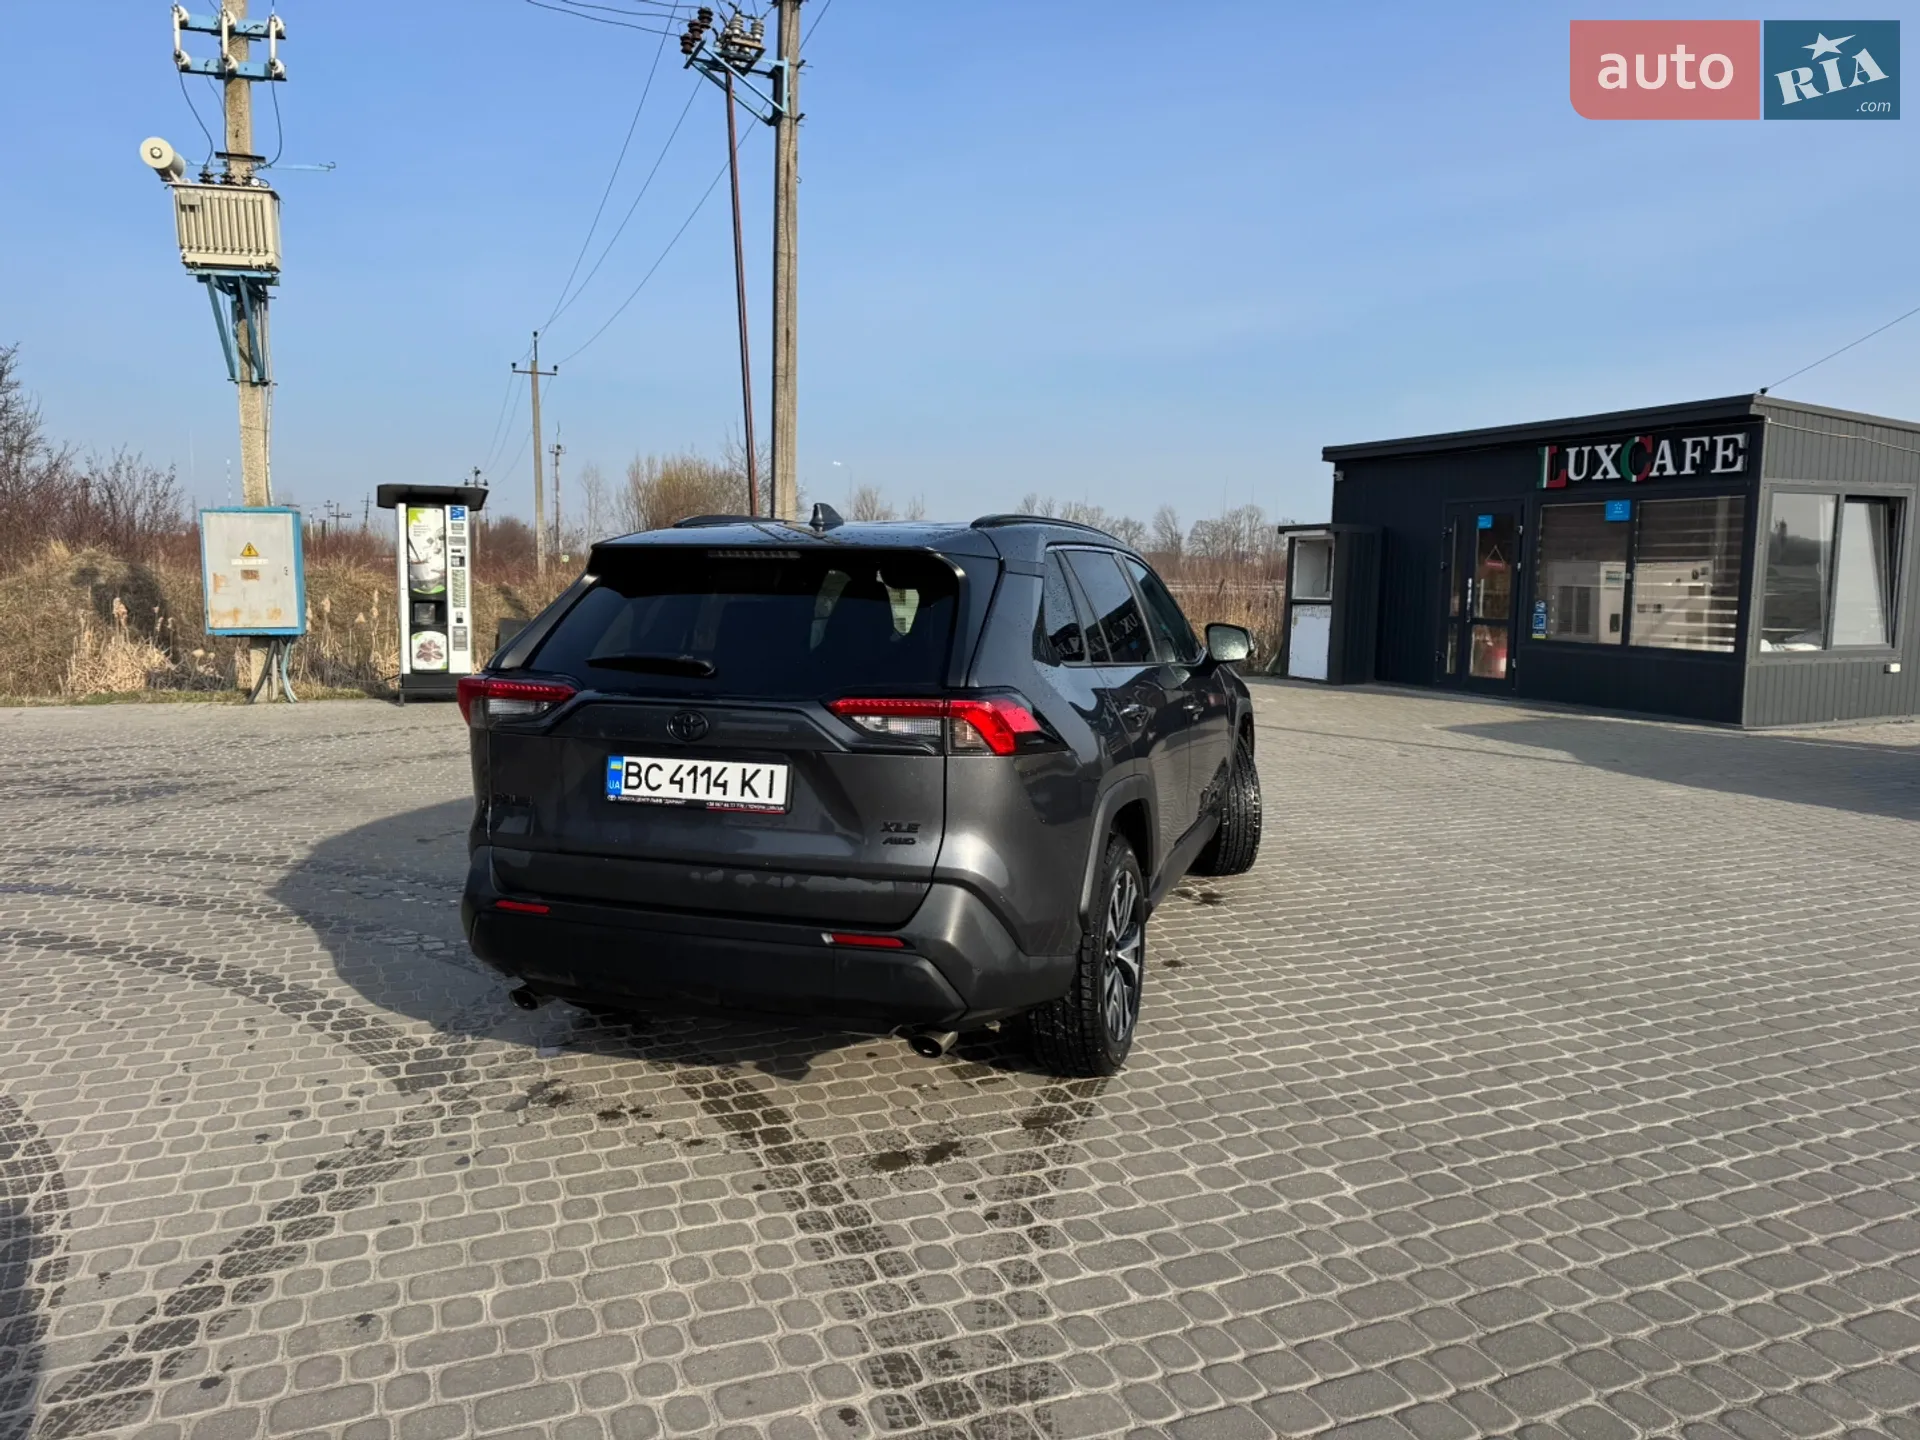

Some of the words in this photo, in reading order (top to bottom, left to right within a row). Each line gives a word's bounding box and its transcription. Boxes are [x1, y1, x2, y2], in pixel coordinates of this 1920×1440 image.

[609, 779, 620, 790] UA
[624, 762, 663, 792] BC
[669, 764, 729, 797] 4114
[740, 768, 775, 799] KI
[880, 821, 921, 833] XLE
